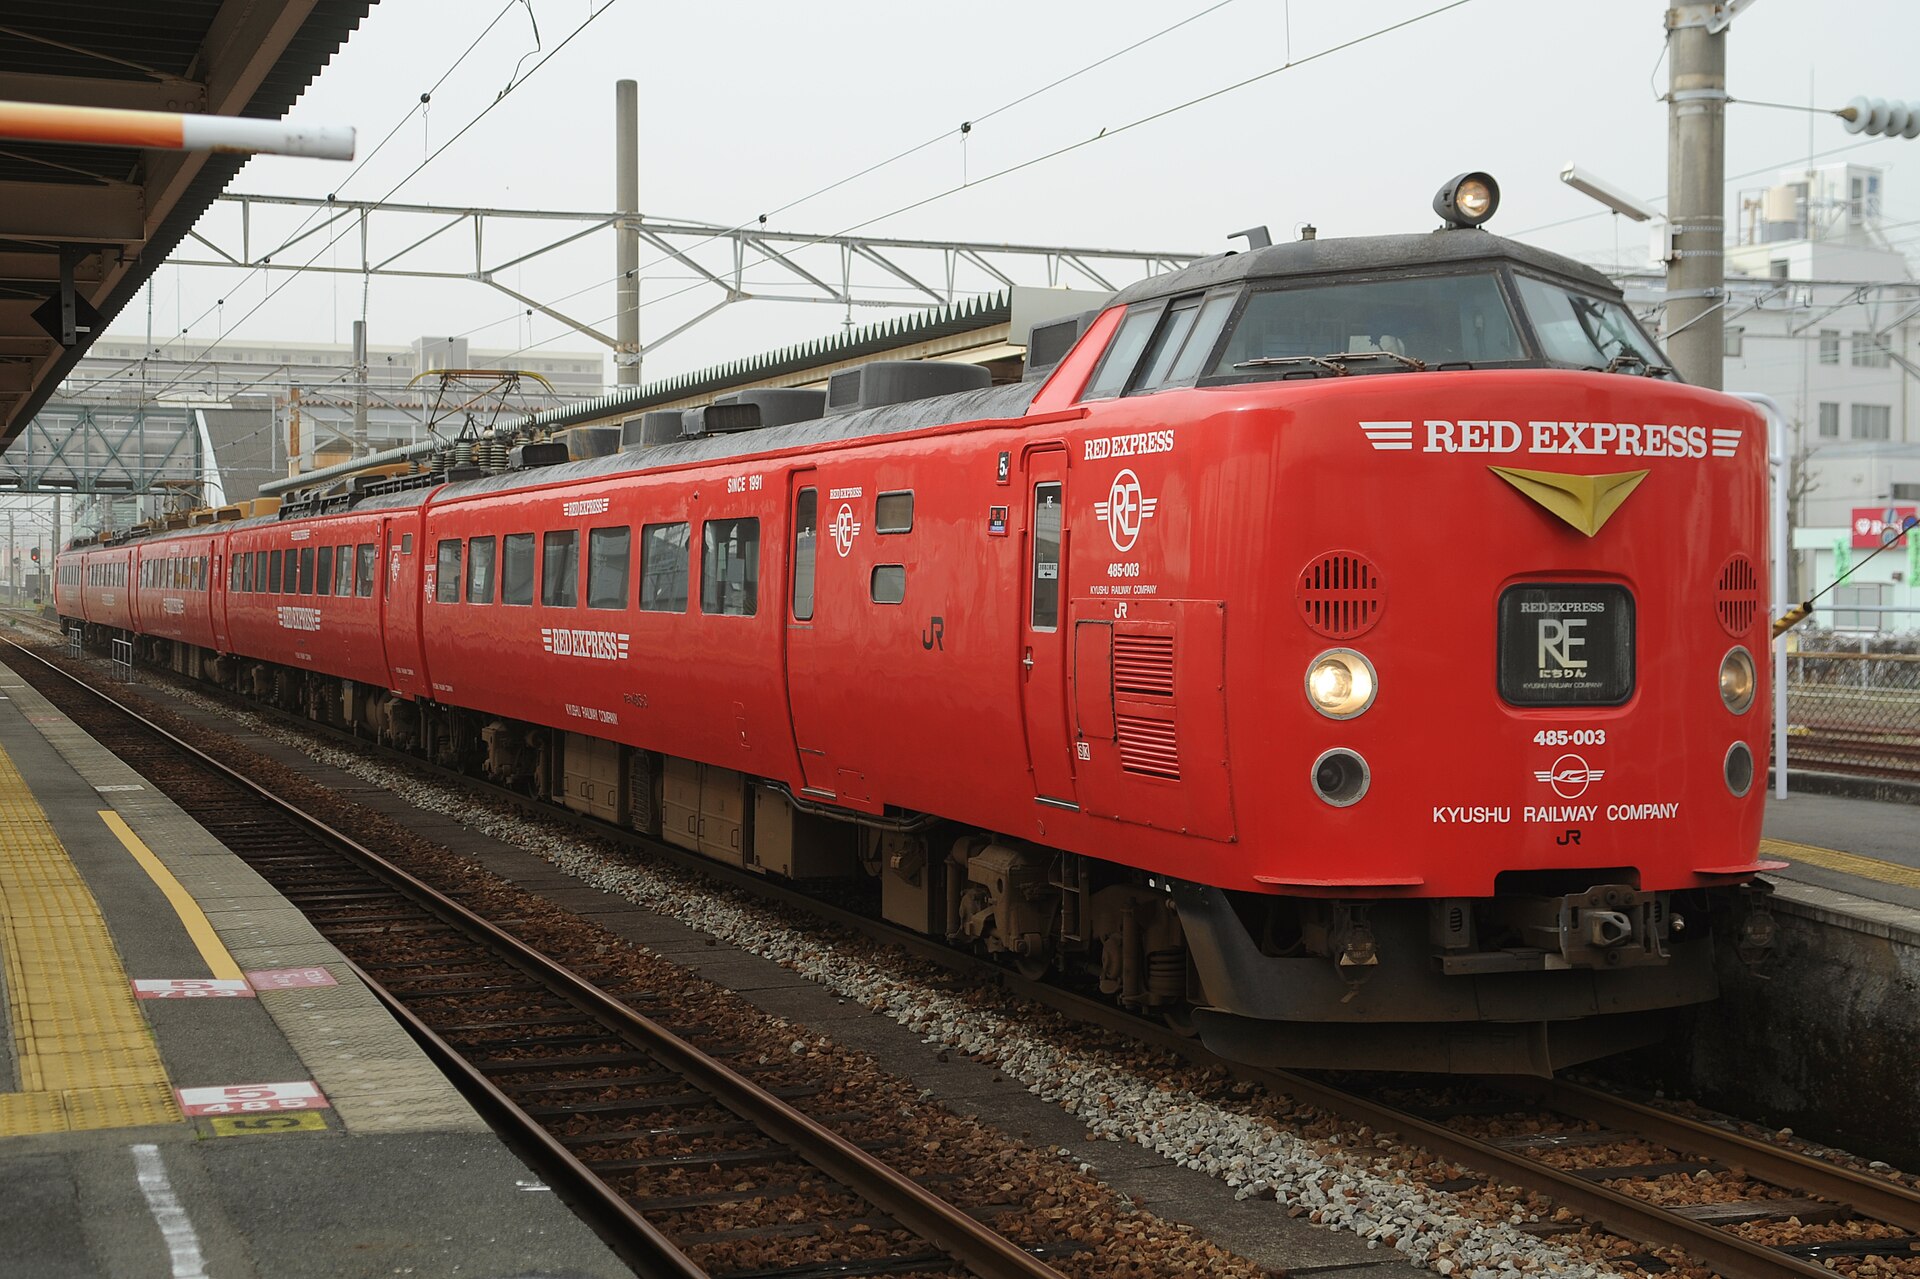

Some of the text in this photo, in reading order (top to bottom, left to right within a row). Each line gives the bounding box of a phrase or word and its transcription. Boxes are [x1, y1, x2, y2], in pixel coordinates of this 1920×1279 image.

[1084, 429, 1174, 461] RED EXPRESS
[1423, 420, 1707, 459] RED EXPRESS
[727, 474, 763, 494] SINCE 1991
[1090, 585, 1157, 595] KYUSHU RAILWAY COMPANY
[1114, 602, 1127, 618] JR
[1520, 602, 1605, 613] RED EXPRESS
[922, 616, 944, 651] JR
[552, 628, 617, 661] RED EXPRESS
[1538, 618, 1588, 668] RE
[1539, 669, 1587, 679] にちりん
[1433, 802, 1679, 823] KYUSHU RAILWAY COMPANY
[1556, 829, 1581, 845] JR
[171, 980, 213, 990] 5
[153, 990, 238, 998] 783
[224, 1086, 276, 1100] 5
[203, 1099, 308, 1113] 485
